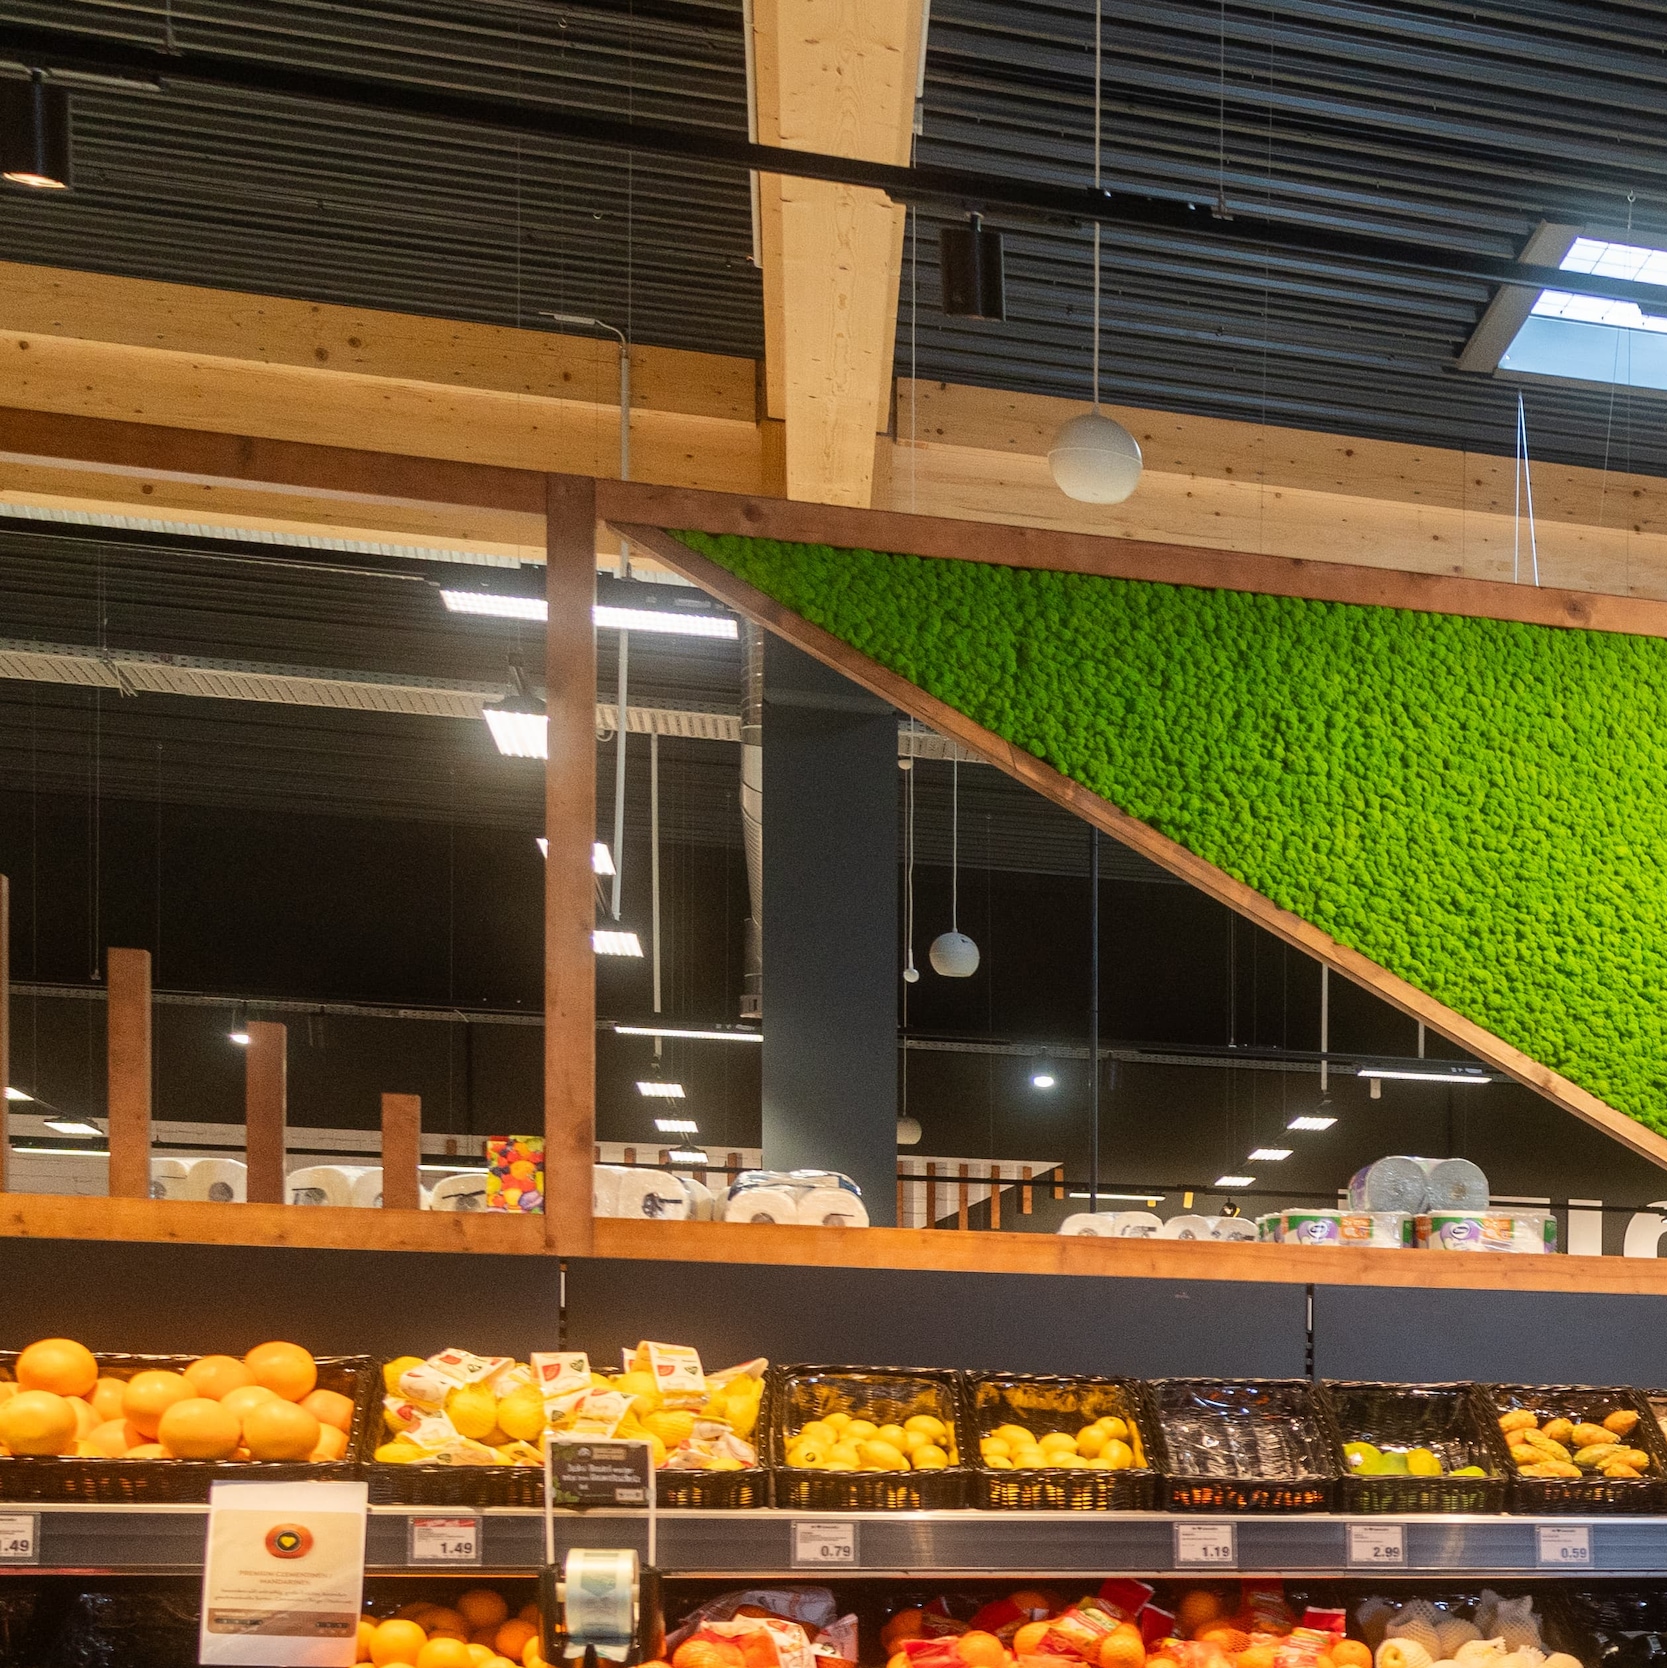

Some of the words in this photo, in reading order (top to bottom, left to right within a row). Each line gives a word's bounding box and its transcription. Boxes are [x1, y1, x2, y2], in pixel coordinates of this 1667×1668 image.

[0, 1540, 29, 1551] .49
[441, 1542, 472, 1553] 1.49
[821, 1545, 851, 1557] 0.79
[1202, 1546, 1230, 1557] 1.19
[1373, 1546, 1400, 1557] 2.99
[1561, 1547, 1587, 1558] 0.59
